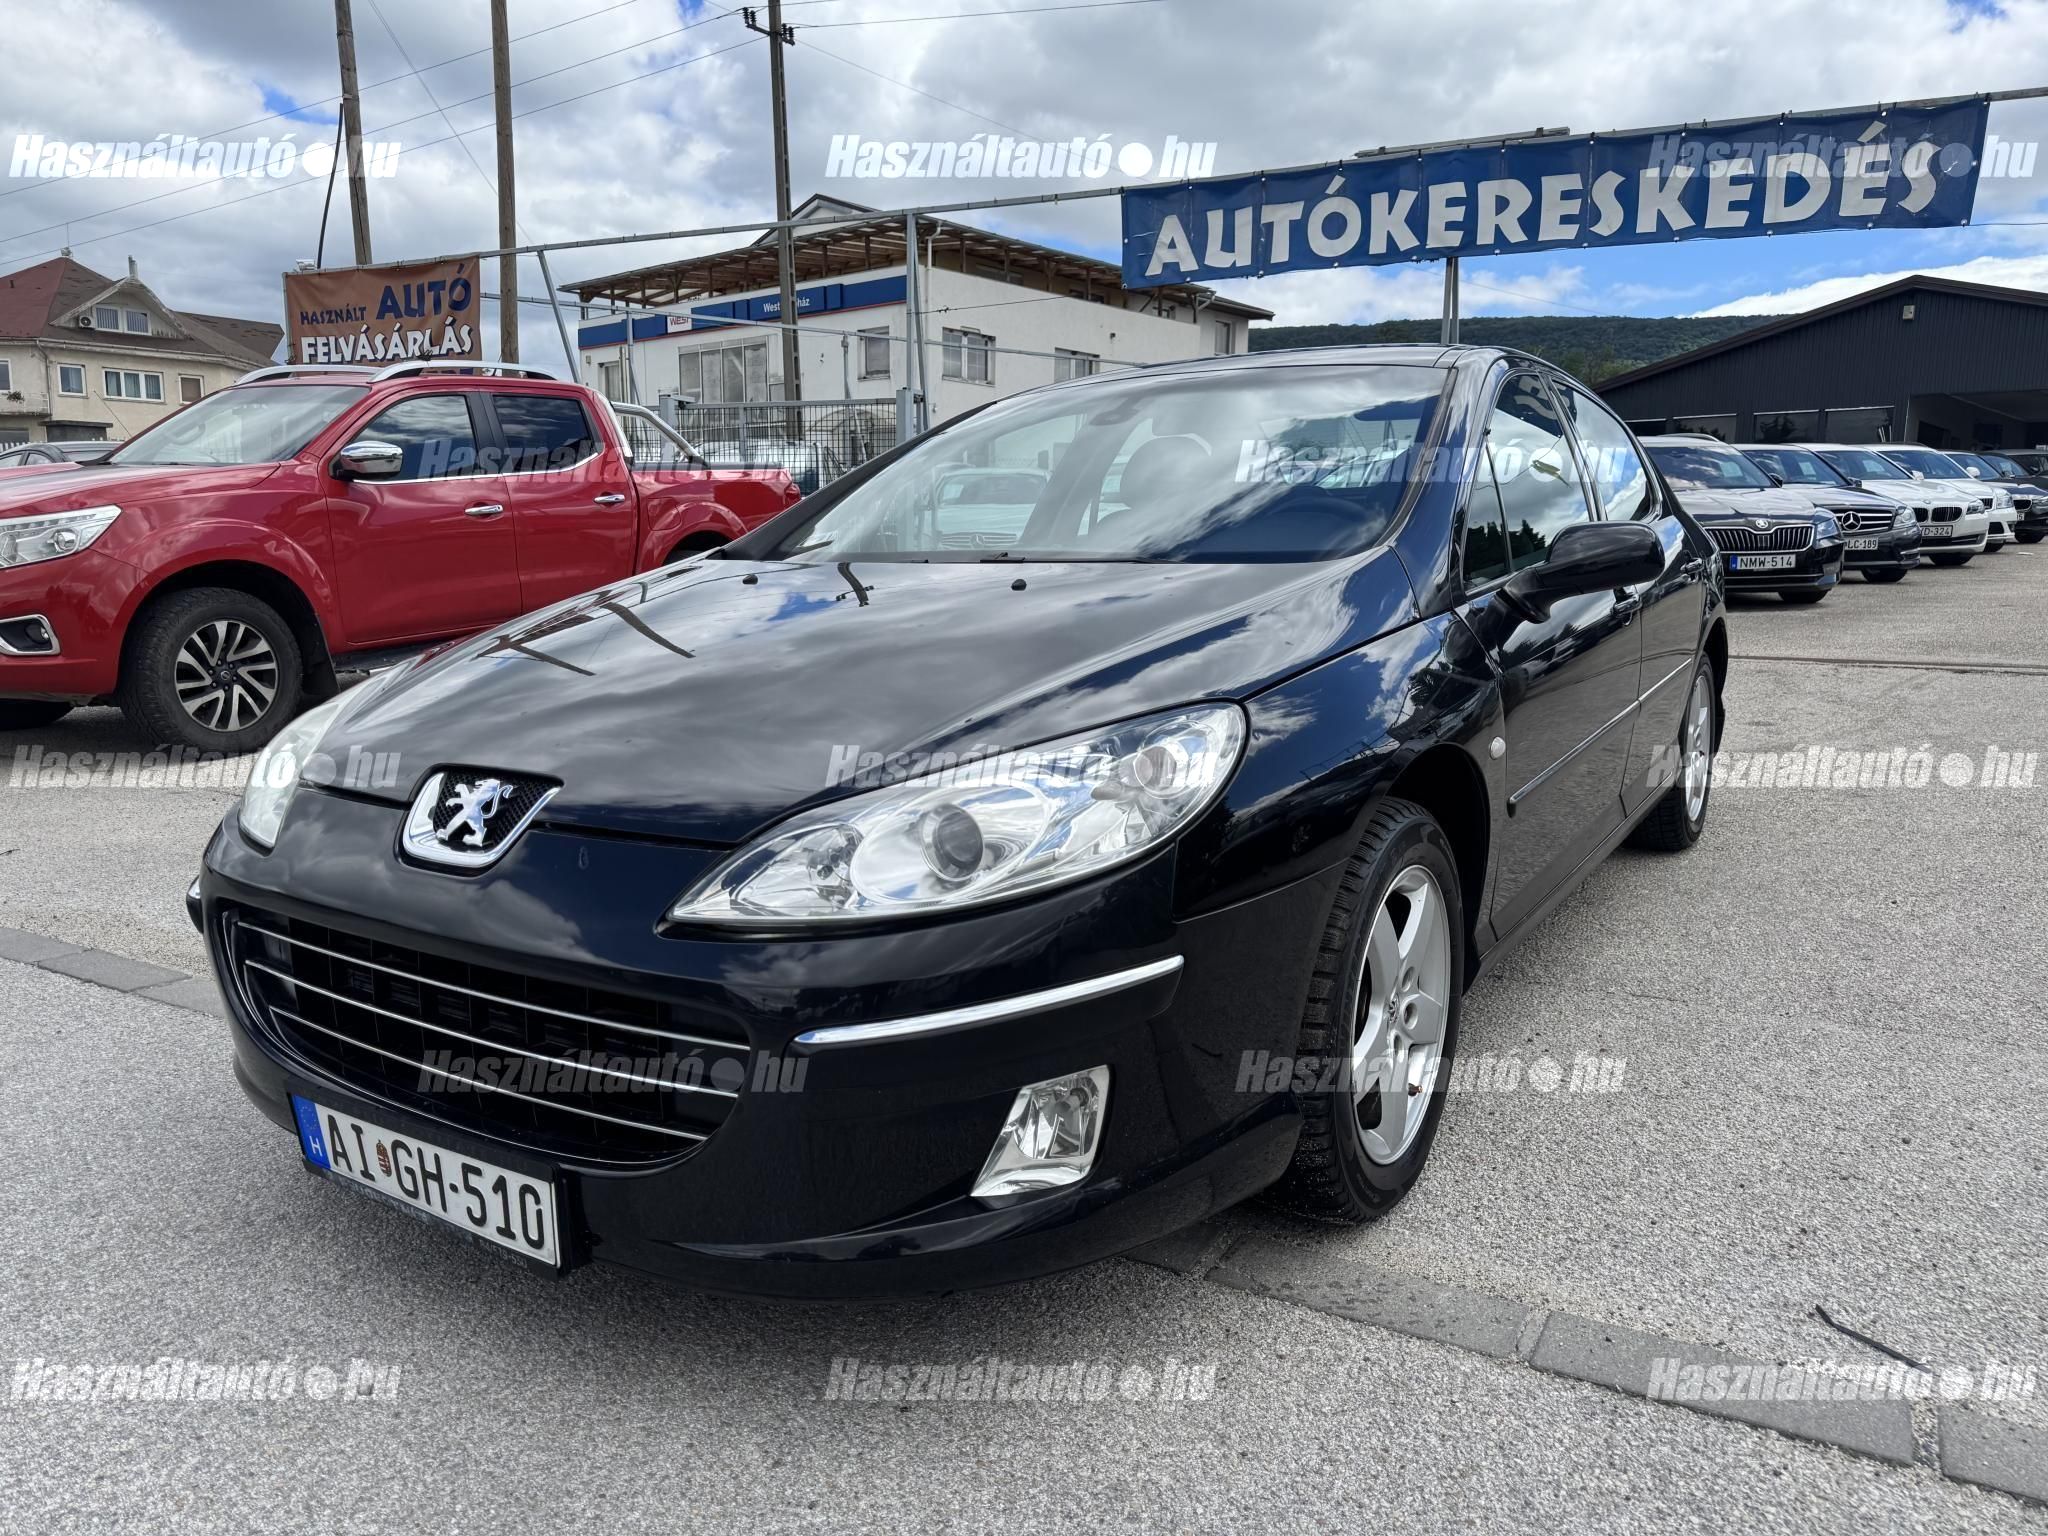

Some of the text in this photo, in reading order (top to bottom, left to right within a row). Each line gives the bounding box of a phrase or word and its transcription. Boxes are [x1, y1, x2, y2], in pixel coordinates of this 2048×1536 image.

[1146, 121, 1943, 276] AUTÓKERESKEDÉS
[300, 263, 472, 326] HASZNÁLT AUTÓ
[301, 316, 473, 365] FELVÁSÁRLÁS
[1739, 555, 1794, 569] NMW-514
